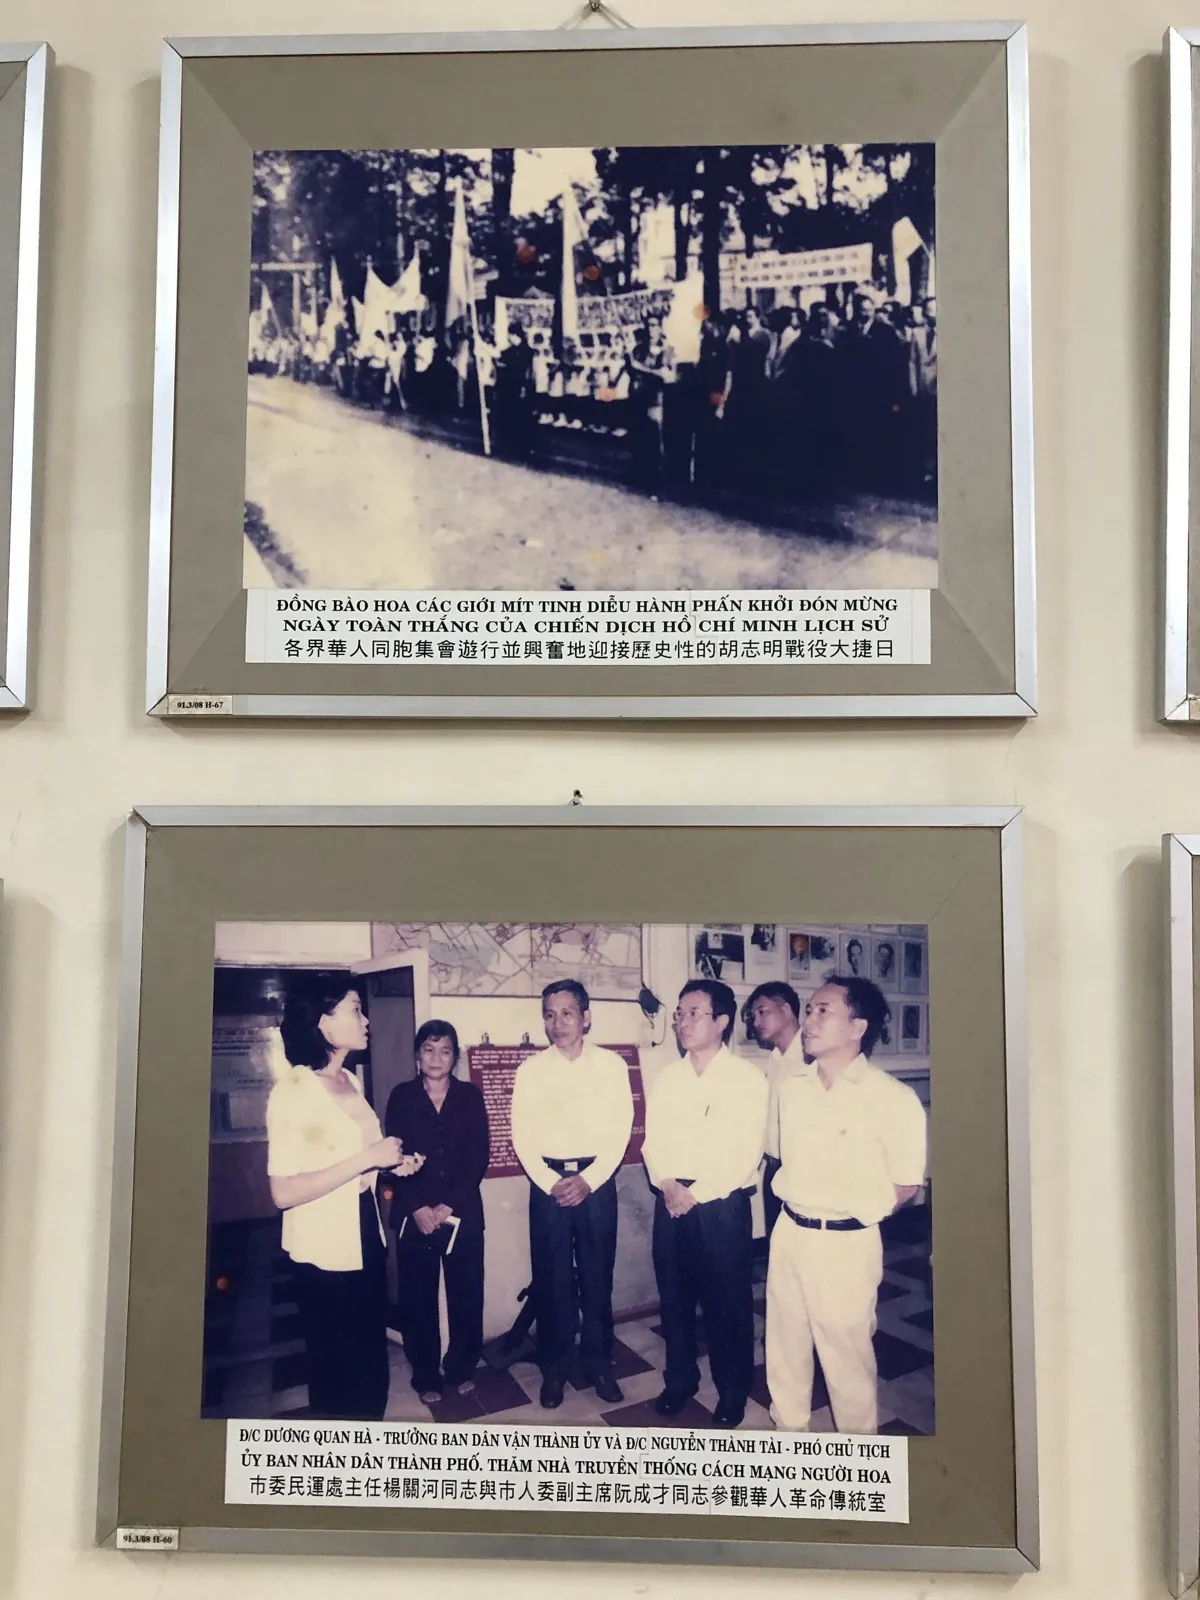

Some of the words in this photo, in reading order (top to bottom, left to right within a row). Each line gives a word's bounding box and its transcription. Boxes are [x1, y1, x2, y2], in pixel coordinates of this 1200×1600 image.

[277, 593, 327, 611] ĐỒNG
[332, 596, 368, 612] BÀO
[374, 600, 410, 612] HOA
[416, 597, 451, 612] CÁC
[457, 597, 495, 612] GIỚI
[501, 597, 534, 612] MÍT
[539, 601, 581, 612] TINH
[587, 595, 631, 612] DIỄU
[636, 597, 686, 612] HÀNH
[692, 595, 742, 611] PHẤN
[748, 595, 793, 611] KHỞI
[799, 596, 838, 611] ĐÓN
[843, 596, 898, 611] MỪNG
[283, 616, 340, 631] NGÀY
[346, 617, 402, 632] TOÀN
[408, 614, 479, 633] THẮNG
[486, 616, 527, 633] CỦA
[534, 616, 599, 633] CHIẾN
[606, 621, 655, 635] DỊCH
[662, 615, 691, 633] HỒ
[699, 617, 735, 632] CHÍ
[742, 620, 798, 632] MINH
[804, 620, 854, 634] LỊCH
[862, 615, 889, 631] SỬ
[176, 701, 203, 709] 91.3/08
[205, 701, 224, 709] H-67
[239, 1429, 260, 1442] Đ/C
[264, 1427, 310, 1443] DƯƠNG
[314, 1430, 350, 1446] QUAN
[354, 1428, 372, 1444] HÀ
[384, 1427, 437, 1445] TRƯỞNG
[441, 1433, 468, 1446] BAN
[472, 1430, 500, 1446] DÂN
[503, 1431, 530, 1450] VẬN
[534, 1432, 579, 1448] THÀNH
[583, 1431, 601, 1449] ỦY
[604, 1433, 622, 1449] VÀ
[626, 1437, 647, 1450] Đ/C
[651, 1431, 706, 1451] NGUYỄN
[709, 1436, 755, 1453] THÀNH
[759, 1437, 782, 1454] TÀI
[794, 1438, 821, 1455] PHÓ
[826, 1438, 854, 1456] CHỦ
[858, 1444, 890, 1460] TỊCH
[241, 1448, 262, 1466] ỦY
[266, 1454, 298, 1467] BAN
[302, 1452, 347, 1468] NHÂN
[351, 1452, 384, 1469] DÂN
[388, 1453, 442, 1470] THÀNH
[446, 1452, 482, 1471] PHỐ.
[488, 1456, 532, 1472] THĂM
[537, 1456, 570, 1473] NHÀ
[575, 1456, 638, 1474] TRUYỀN
[643, 1456, 697, 1476] THỐNG
[702, 1460, 745, 1478] CÁCH
[750, 1465, 796, 1482] MẠNG
[801, 1464, 852, 1482] NGƯỜI
[857, 1469, 891, 1483] HOA
